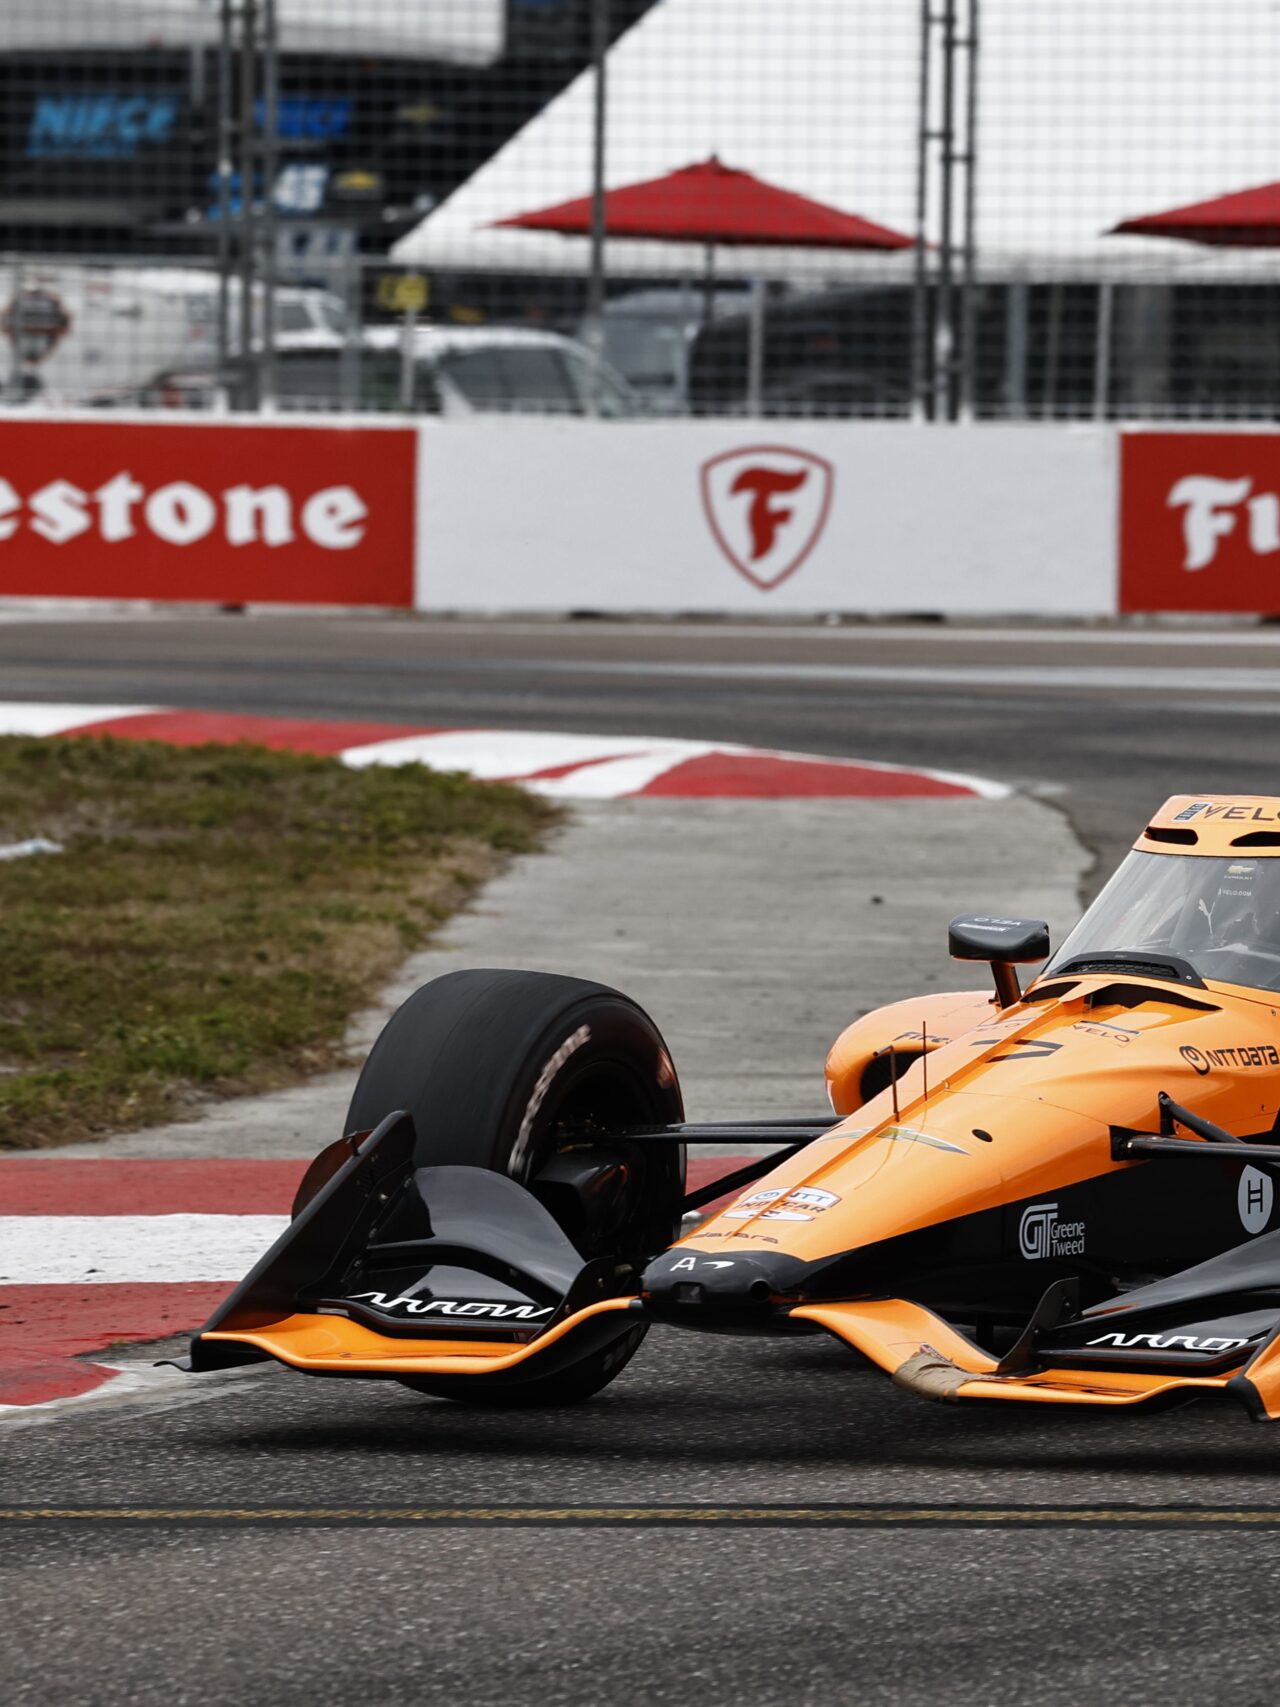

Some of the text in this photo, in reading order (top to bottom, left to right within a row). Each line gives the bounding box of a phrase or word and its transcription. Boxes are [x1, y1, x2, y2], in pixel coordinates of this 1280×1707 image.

[892, 1031, 952, 1045] Fire
[1073, 1024, 1129, 1043] VELO
[1051, 1221, 1086, 1239] Greene
[1051, 1236, 1086, 1257] Tweed
[346, 1291, 556, 1319] ARROW
[1086, 1333, 1250, 1350] ARRO
